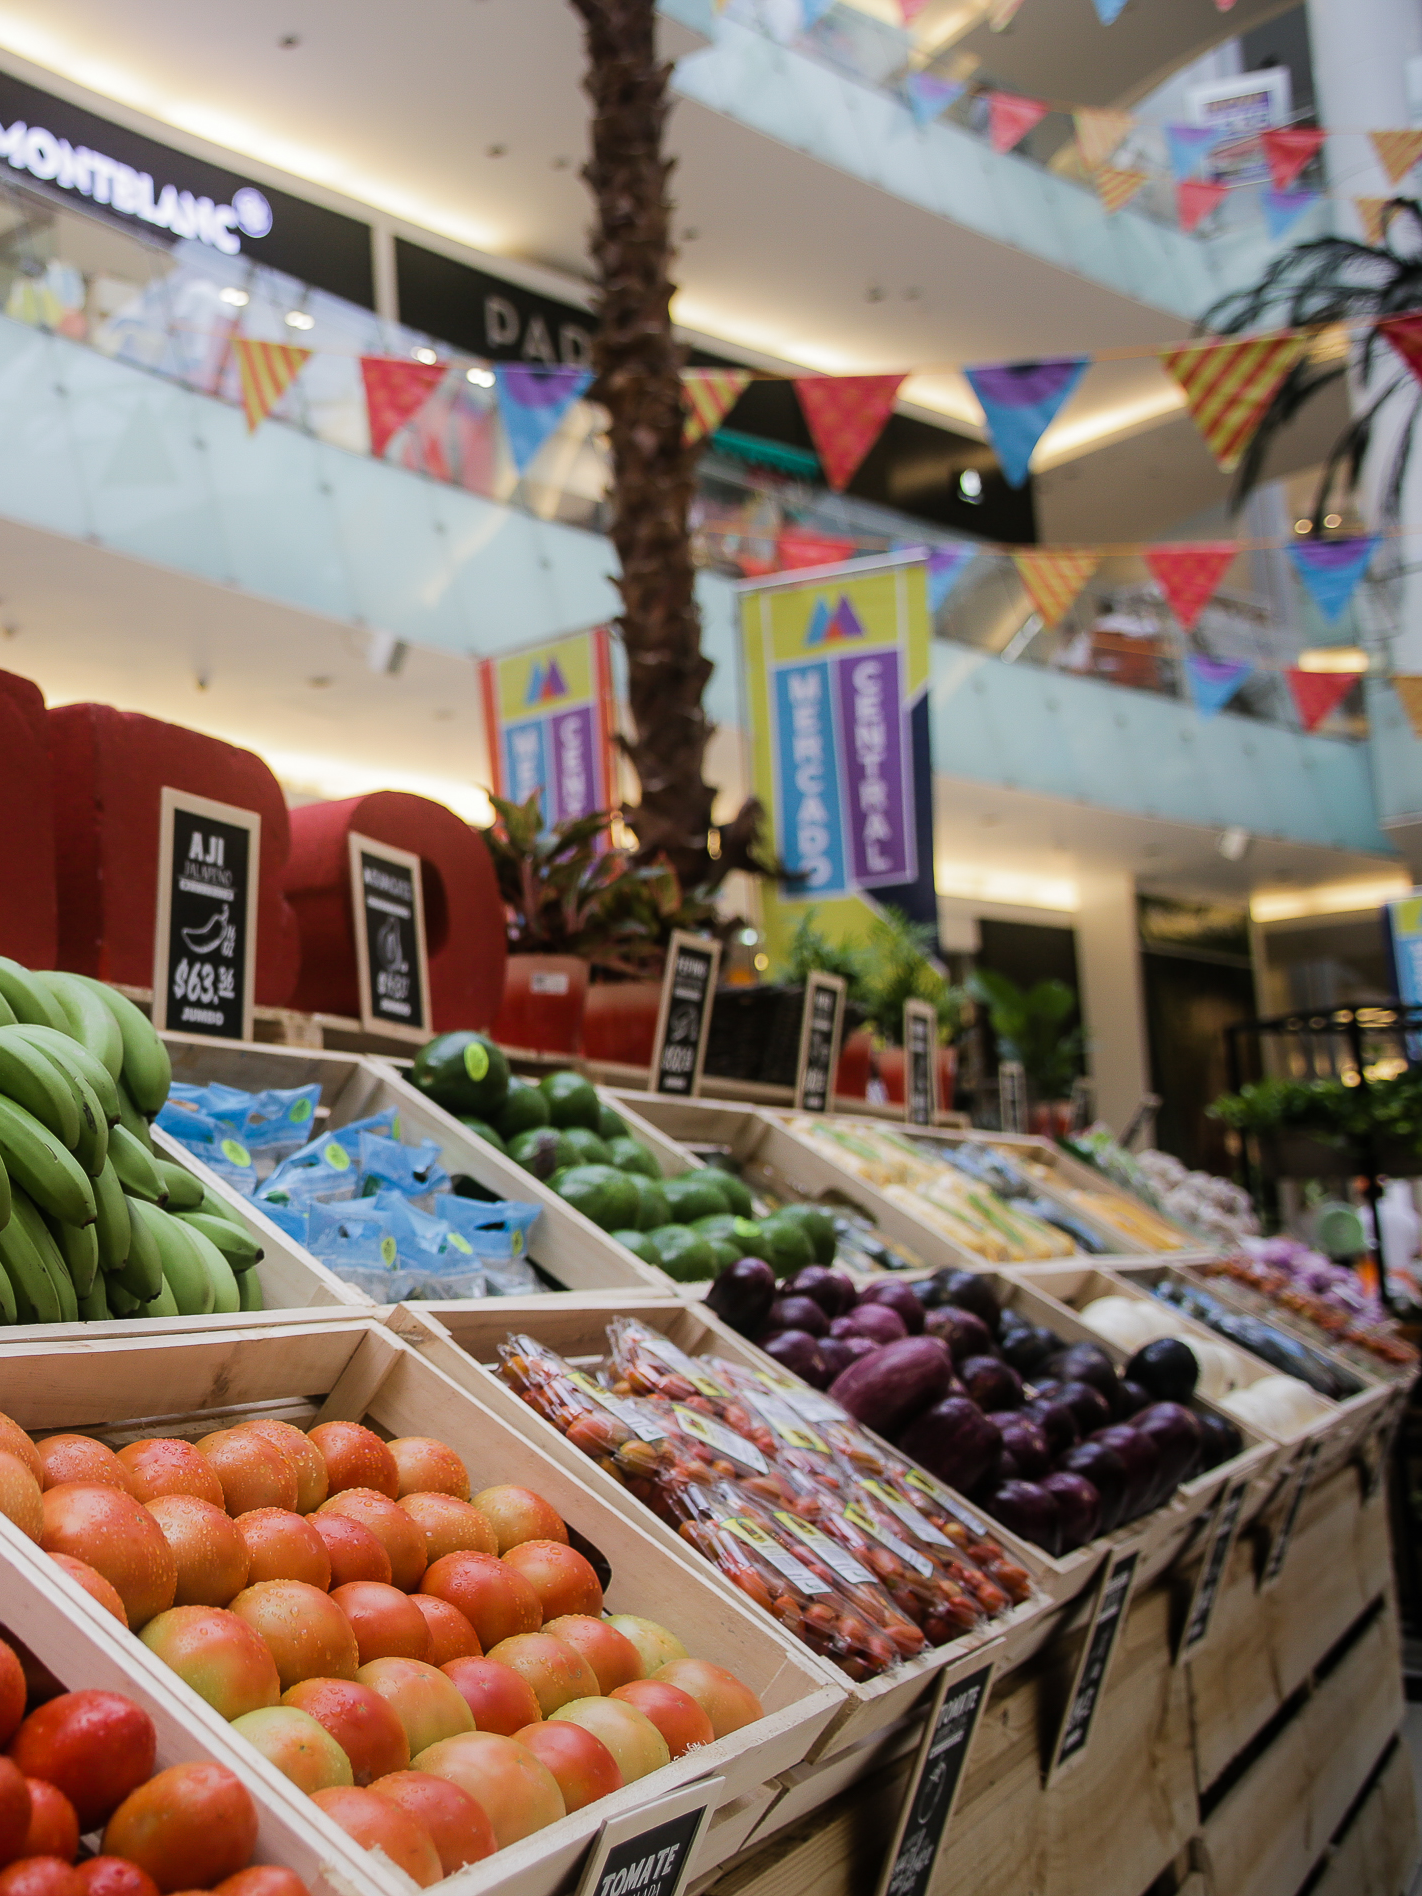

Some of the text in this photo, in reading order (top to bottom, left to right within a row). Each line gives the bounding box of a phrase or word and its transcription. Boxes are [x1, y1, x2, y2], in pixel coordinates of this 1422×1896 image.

[787, 669, 833, 887] MERCADO
[851, 659, 894, 873] CENTRAL
[188, 831, 225, 867] AJI
[599, 1842, 680, 1896] TOMATE
